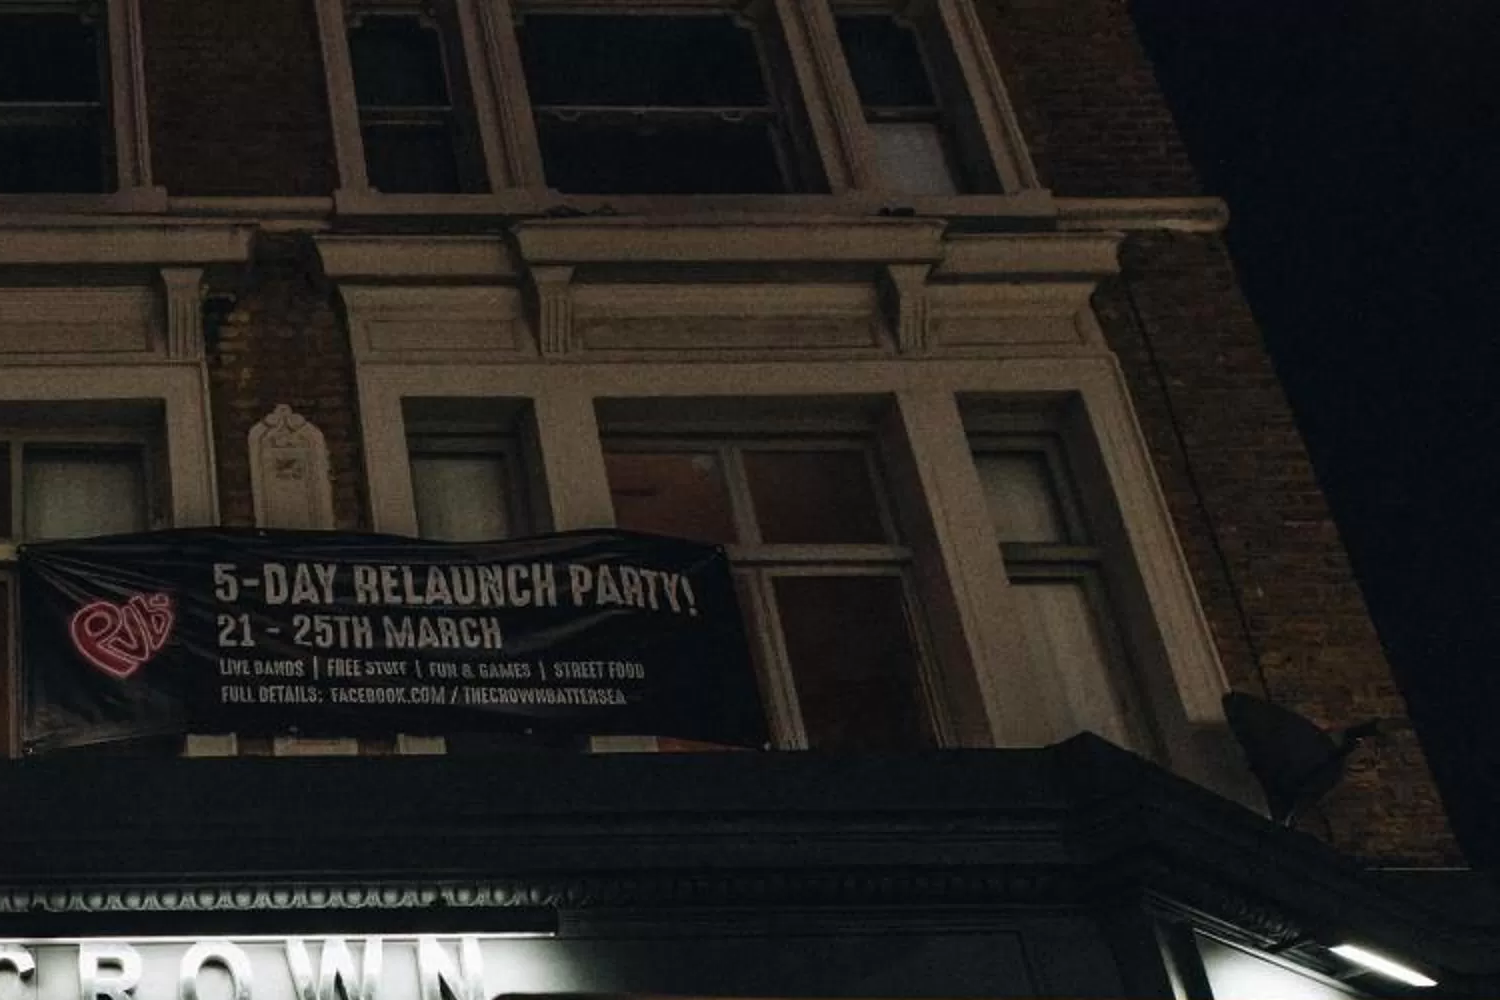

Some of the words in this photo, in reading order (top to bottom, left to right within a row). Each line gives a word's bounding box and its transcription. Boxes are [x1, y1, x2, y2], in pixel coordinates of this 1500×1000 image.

[213, 563, 337, 605] 5-DAY
[353, 563, 557, 607] RELAUNCH
[569, 564, 698, 616] PARTY!
[217, 612, 256, 648] 21
[292, 614, 373, 649] 25TH
[381, 615, 504, 649] MARCH
[219, 658, 251, 676] LIVE
[253, 659, 304, 677] BANDS
[327, 658, 363, 677] FREE
[364, 661, 408, 677] STUFF
[429, 661, 458, 678] FUN
[461, 663, 476, 679] &
[479, 662, 532, 680] GAMES
[553, 661, 606, 680] STREET
[608, 663, 646, 680] FOOD
[221, 685, 257, 703] FULL
[259, 686, 324, 704] DETAILS:
